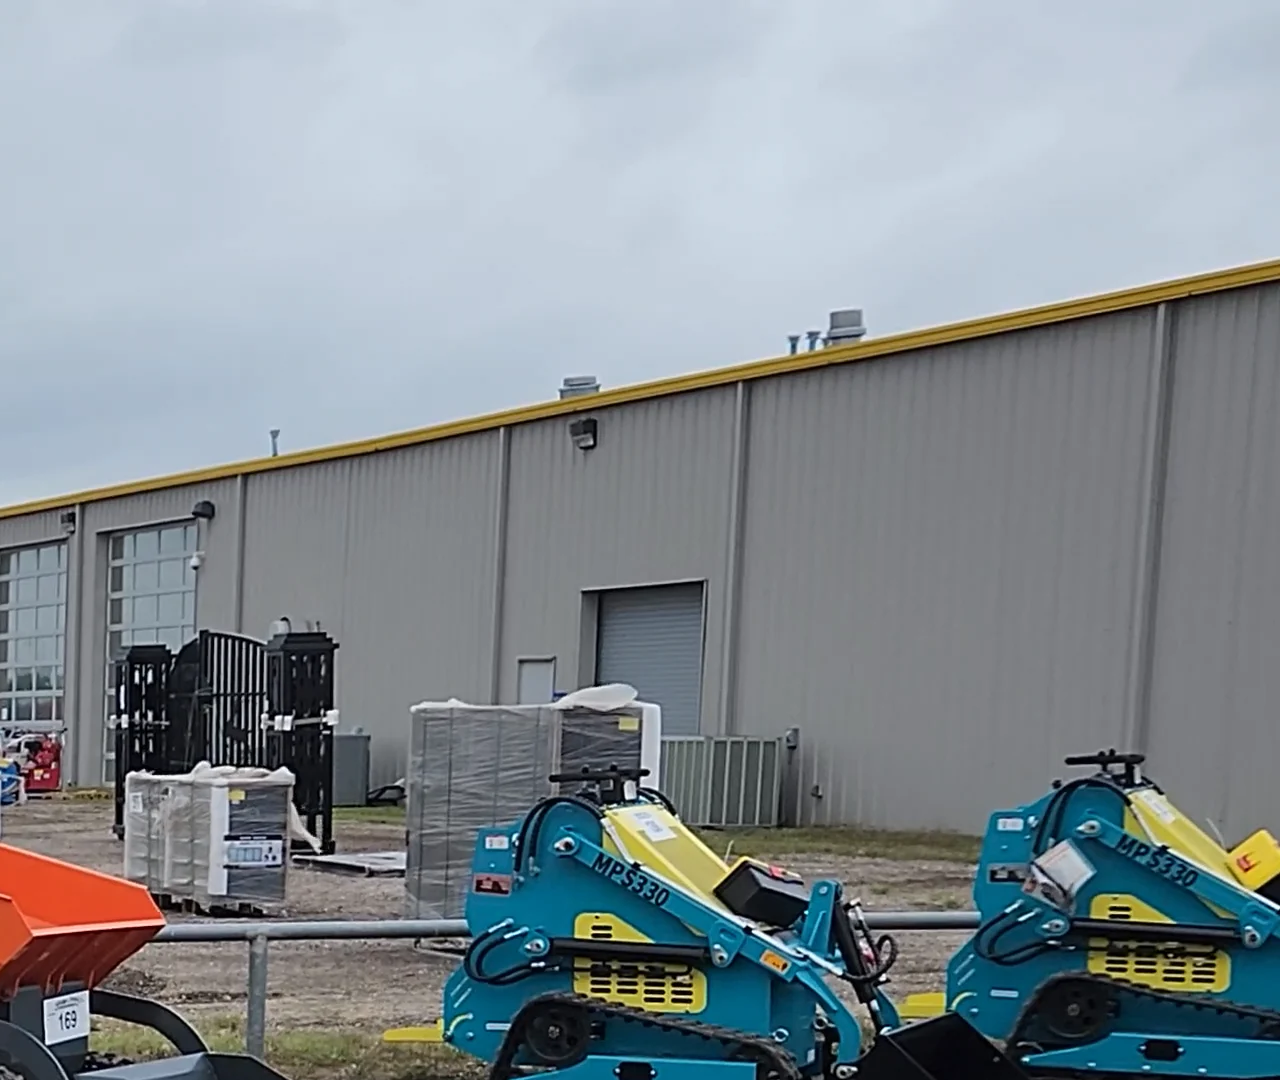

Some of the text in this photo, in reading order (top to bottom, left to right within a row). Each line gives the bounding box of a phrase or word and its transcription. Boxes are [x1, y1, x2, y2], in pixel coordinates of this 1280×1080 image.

[592, 852, 670, 906] MPS330
[1115, 834, 1199, 886] MPS330
[59, 1010, 77, 1030] 169
